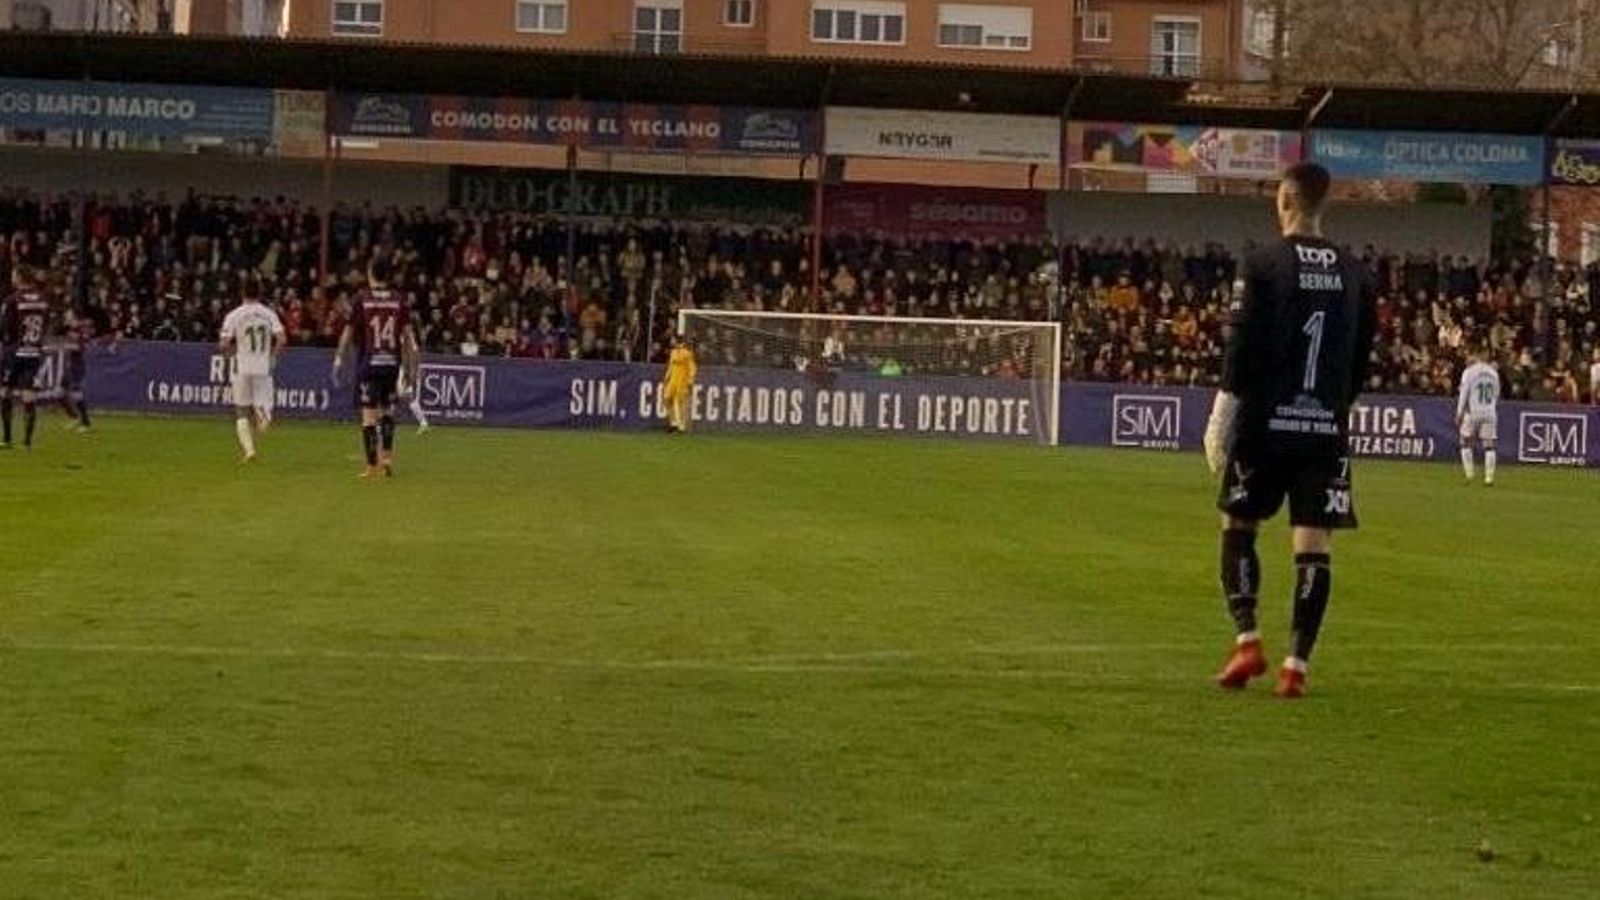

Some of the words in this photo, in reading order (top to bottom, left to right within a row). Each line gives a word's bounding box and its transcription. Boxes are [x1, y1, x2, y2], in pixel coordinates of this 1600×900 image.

[106, 98, 196, 120] MARCO
[430, 110, 540, 131] COMODON
[546, 116, 590, 133] CON
[597, 118, 619, 134] EL
[629, 119, 722, 138] YECLANO
[1295, 243, 1337, 269] top
[244, 324, 266, 353] 11
[369, 314, 396, 350] 14
[1302, 310, 1326, 391] 1
[423, 374, 475, 408] SIM
[815, 389, 866, 428] CON
[878, 392, 905, 429] EL
[918, 394, 1030, 435] DEPORTE
[1119, 405, 1172, 438] SIM
[1526, 422, 1577, 455] SIM
